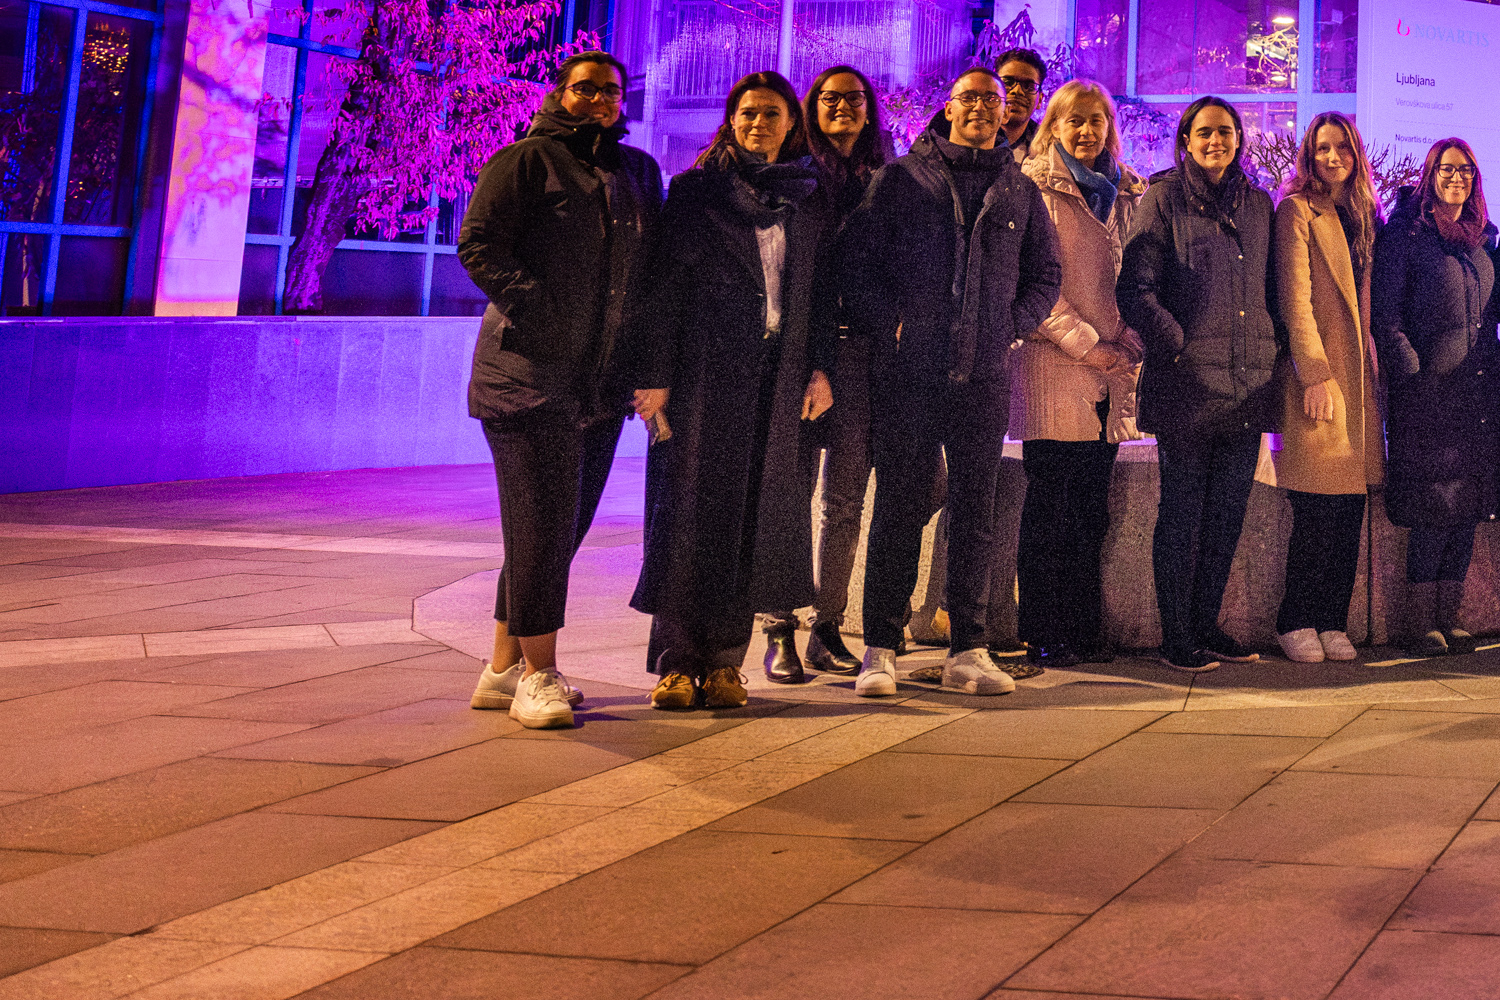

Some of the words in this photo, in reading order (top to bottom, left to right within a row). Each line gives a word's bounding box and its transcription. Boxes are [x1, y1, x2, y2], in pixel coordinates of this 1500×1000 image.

[1415, 24, 1490, 48] NOVARTIS
[1396, 72, 1435, 87] Ljubljana
[1395, 133, 1421, 143] Novartis
